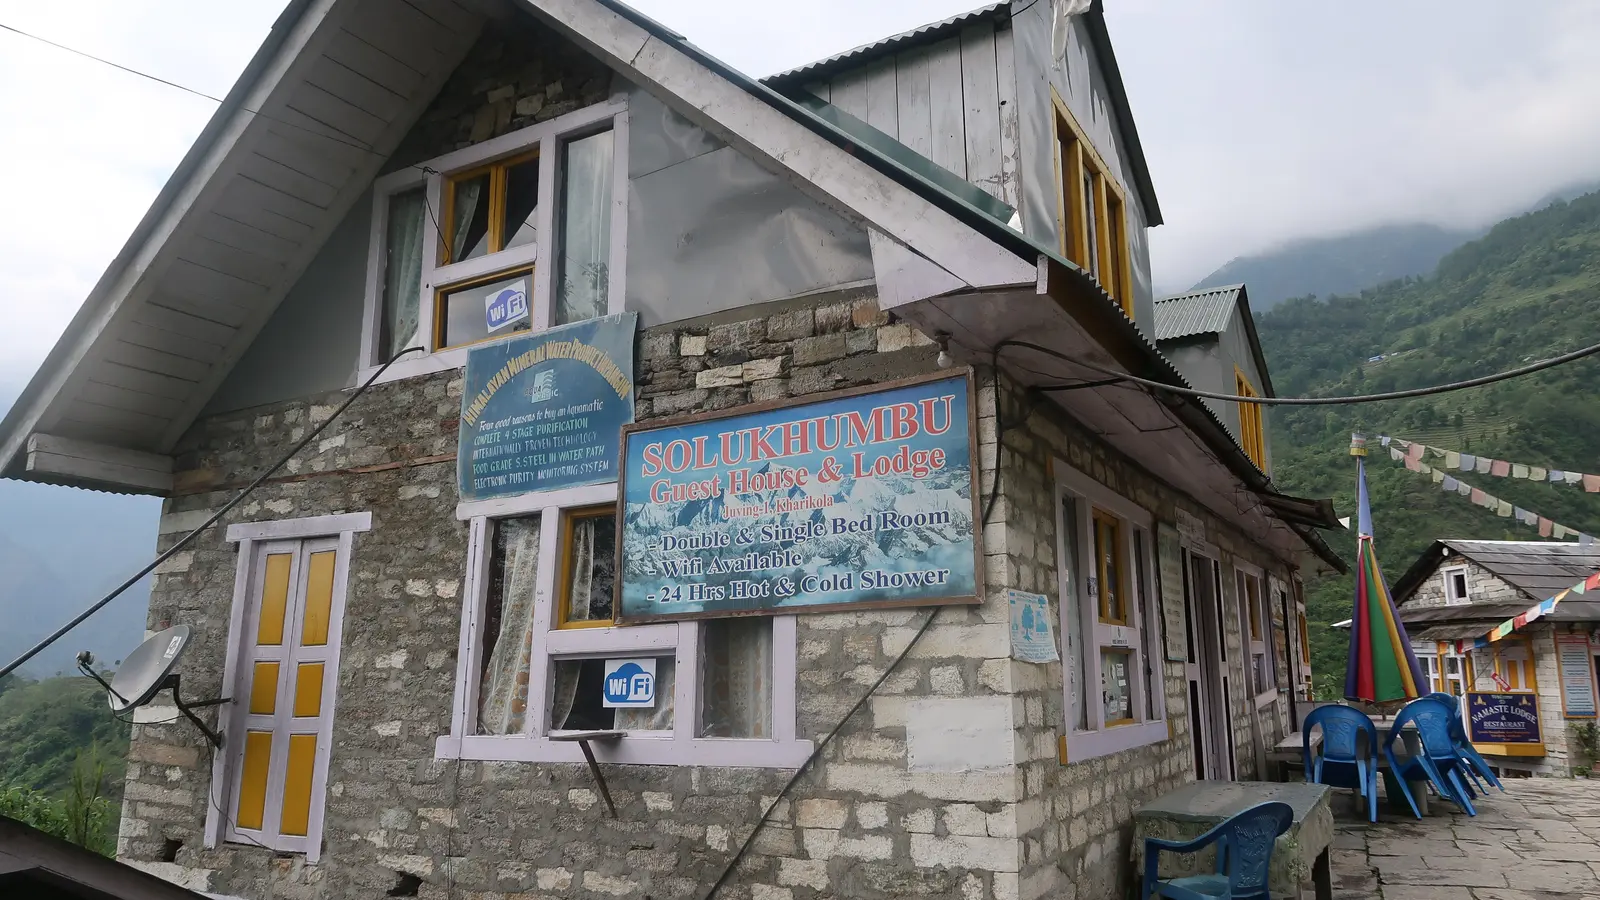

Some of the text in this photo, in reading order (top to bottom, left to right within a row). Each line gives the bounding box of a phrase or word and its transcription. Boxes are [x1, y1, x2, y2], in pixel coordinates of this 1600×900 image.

[463, 365, 511, 427] HIMALAYAN
[507, 344, 546, 377] MINERAL
[546, 340, 573, 360] WATER
[495, 415, 512, 431] good
[512, 412, 536, 425] reasons
[536, 410, 543, 421] to
[544, 408, 557, 421] buy
[557, 407, 566, 417] an
[567, 399, 604, 417] Aquamatic
[474, 417, 588, 446] COMPLETE 4 STAGE PURIFICATION
[525, 438, 551, 452] PROVEN
[553, 431, 598, 448] TECHNOLOGY
[642, 394, 955, 477] SOLUKHUMBU
[473, 462, 489, 475] FOOD
[490, 458, 513, 472] GRADE
[549, 452, 557, 463] IN
[558, 448, 584, 462] WATER
[586, 444, 605, 458] PATH
[509, 471, 535, 484] PURITY
[537, 464, 579, 480] MONITORING
[580, 459, 609, 474] SYSTEM
[650, 445, 946, 505] Guest House & Lodge
[775, 493, 833, 513] Kharikola
[661, 531, 730, 551] Double
[735, 526, 755, 545] &
[760, 520, 825, 543] Single
[831, 514, 873, 535] Bed
[880, 510, 951, 531] Room
[661, 556, 703, 578] Wifi
[707, 550, 802, 574] Available
[660, 584, 682, 604] 24
[688, 582, 725, 601] Hrs
[729, 579, 770, 599] Hot
[774, 576, 796, 597] &
[801, 572, 853, 594] Cold
[859, 568, 950, 590] Shower
[1471, 704, 1537, 724] NAMASTE LODGE
[1483, 721, 1526, 729] RESTAURANT
